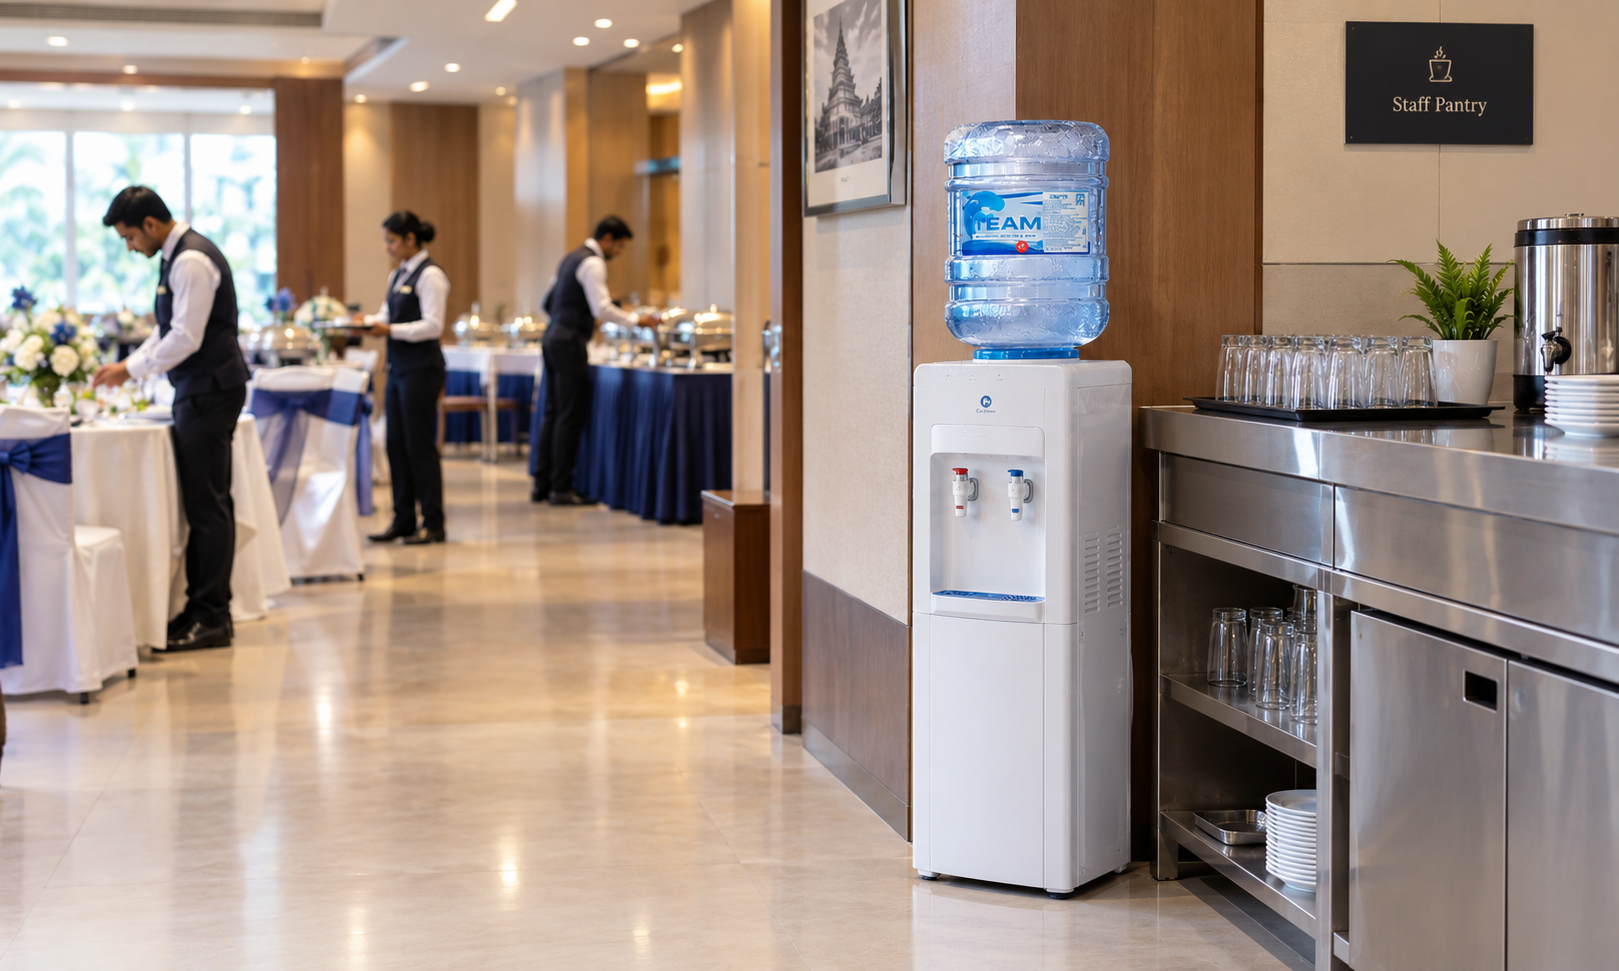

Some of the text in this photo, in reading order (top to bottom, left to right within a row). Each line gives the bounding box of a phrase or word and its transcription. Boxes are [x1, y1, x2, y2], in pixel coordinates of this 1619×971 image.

[1393, 96, 1487, 117] Staff Pantry
[974, 216, 1042, 231] TEAM
